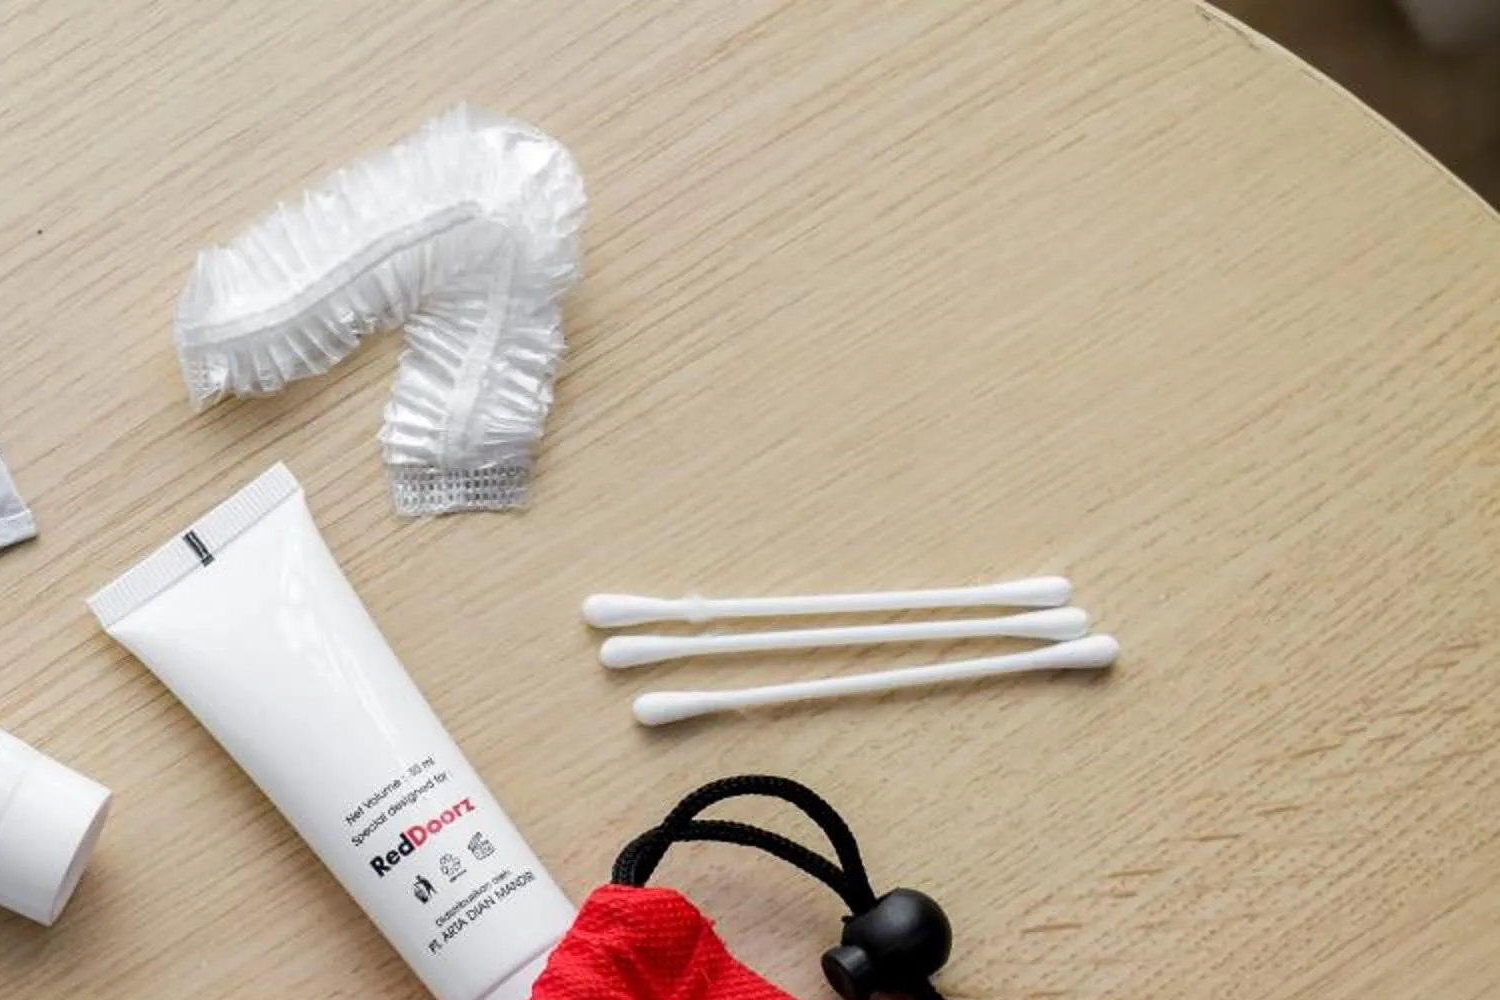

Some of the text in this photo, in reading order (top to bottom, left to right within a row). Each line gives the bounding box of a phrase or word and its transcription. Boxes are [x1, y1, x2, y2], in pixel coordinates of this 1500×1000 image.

[345, 806, 364, 826] Net
[351, 812, 388, 846] Special
[387, 778, 435, 816] designed
[369, 797, 477, 878] RedDoorz
